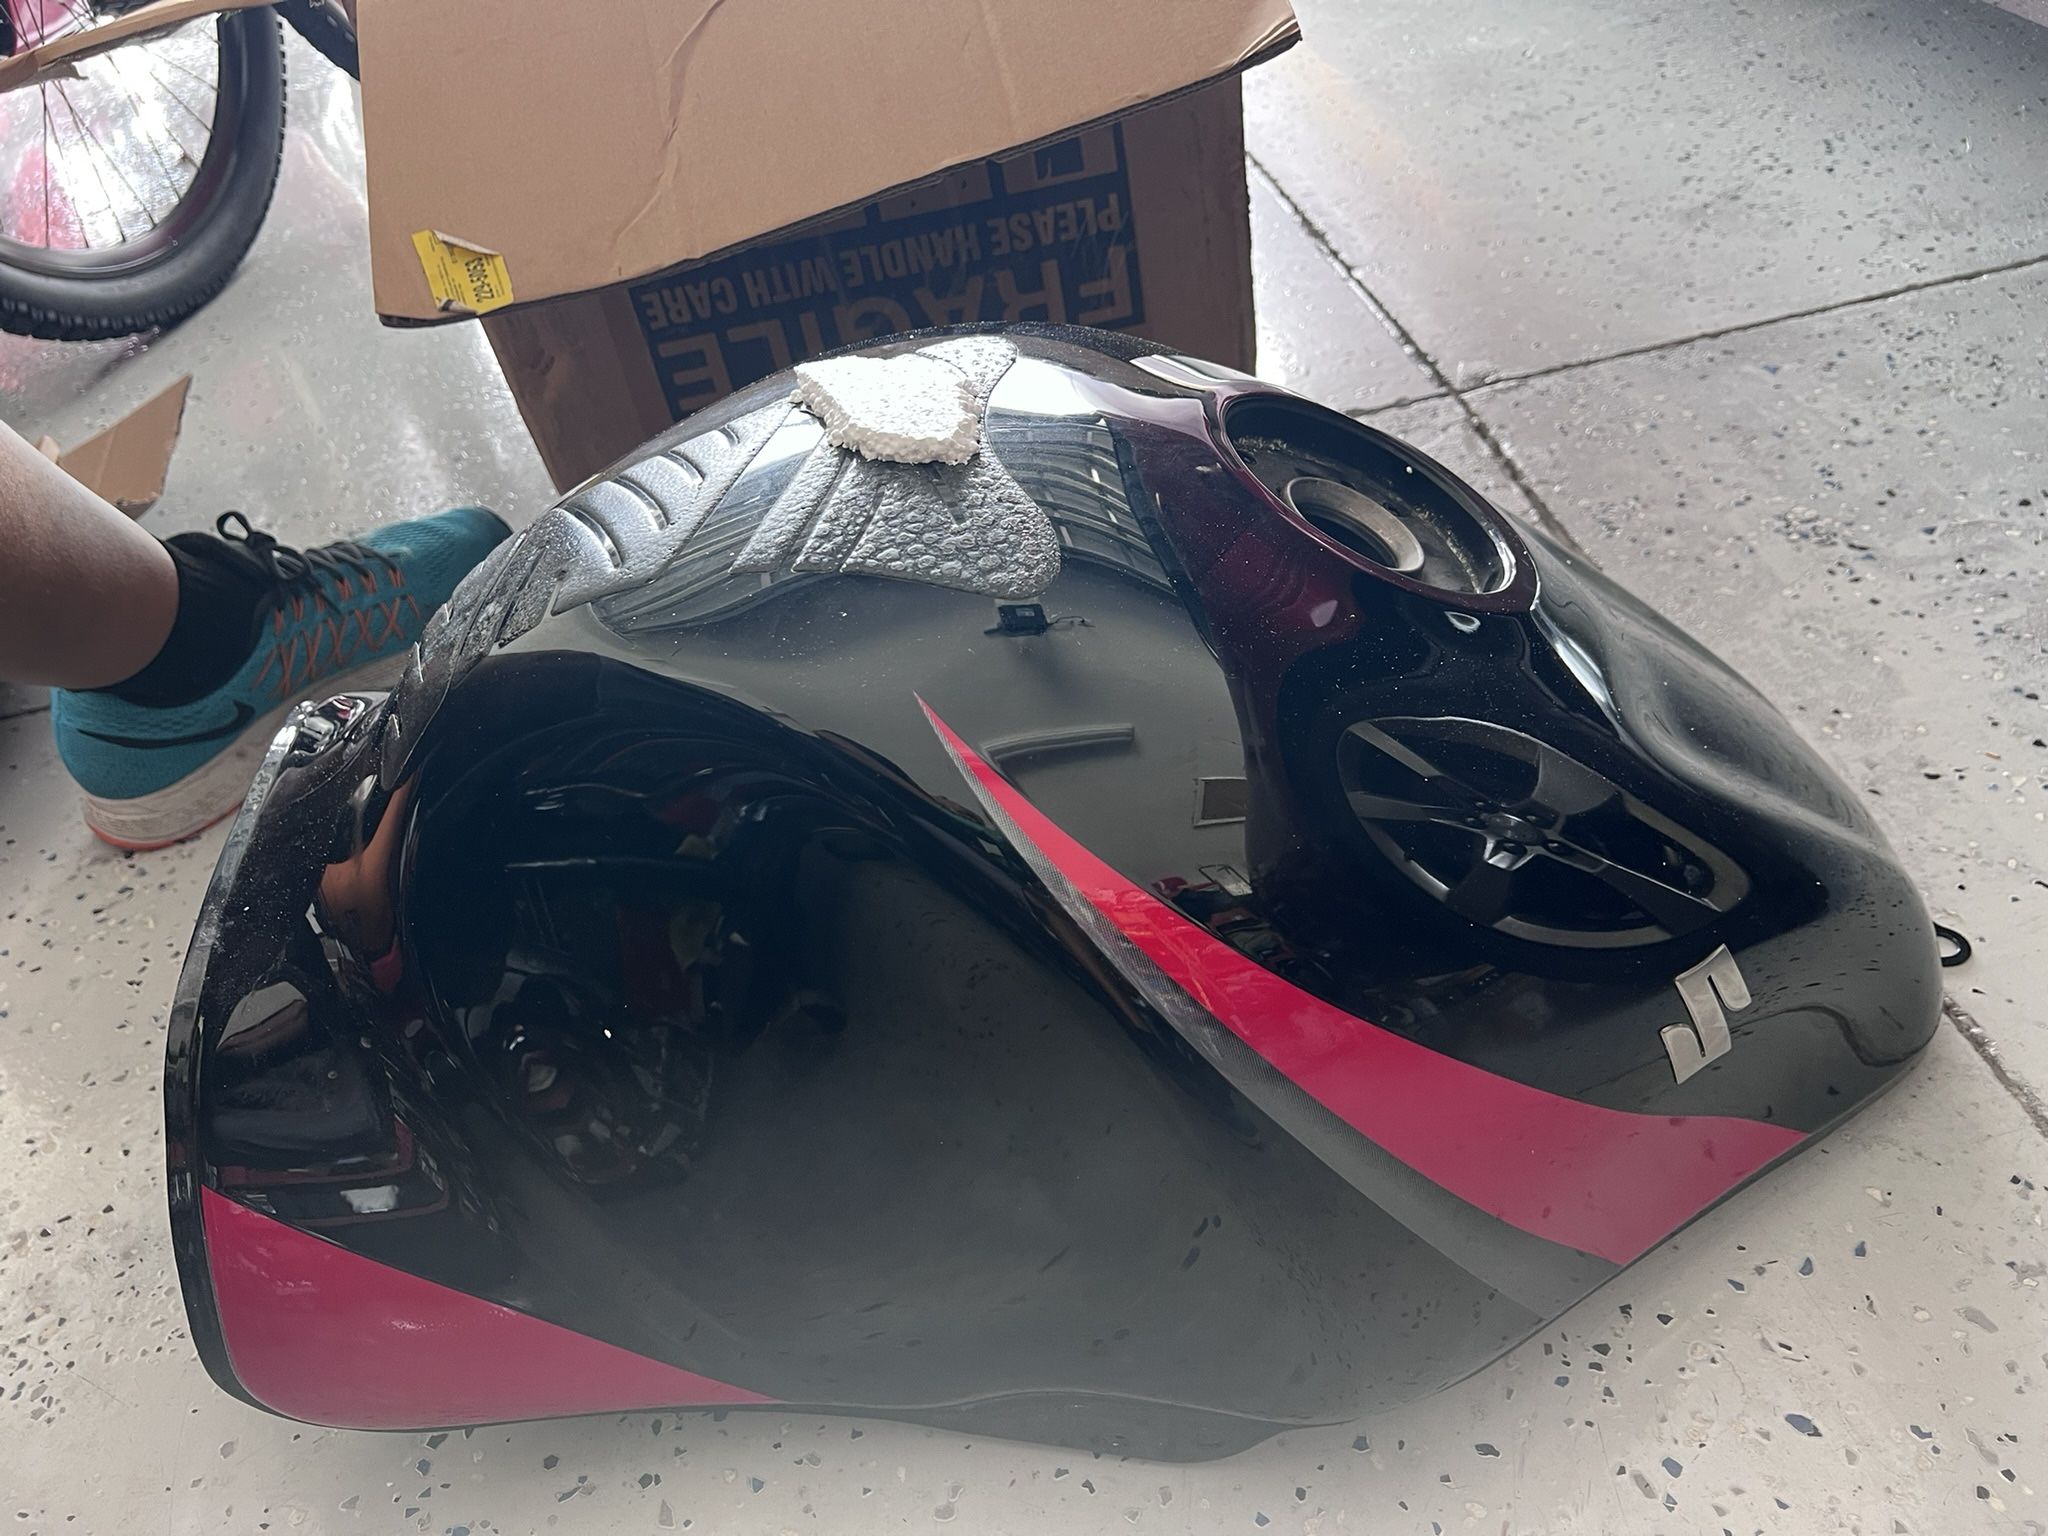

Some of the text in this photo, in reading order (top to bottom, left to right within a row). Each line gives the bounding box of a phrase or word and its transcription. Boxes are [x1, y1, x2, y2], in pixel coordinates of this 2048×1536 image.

[642, 193, 1118, 330] PLEASE HANDLE WITH CARE
